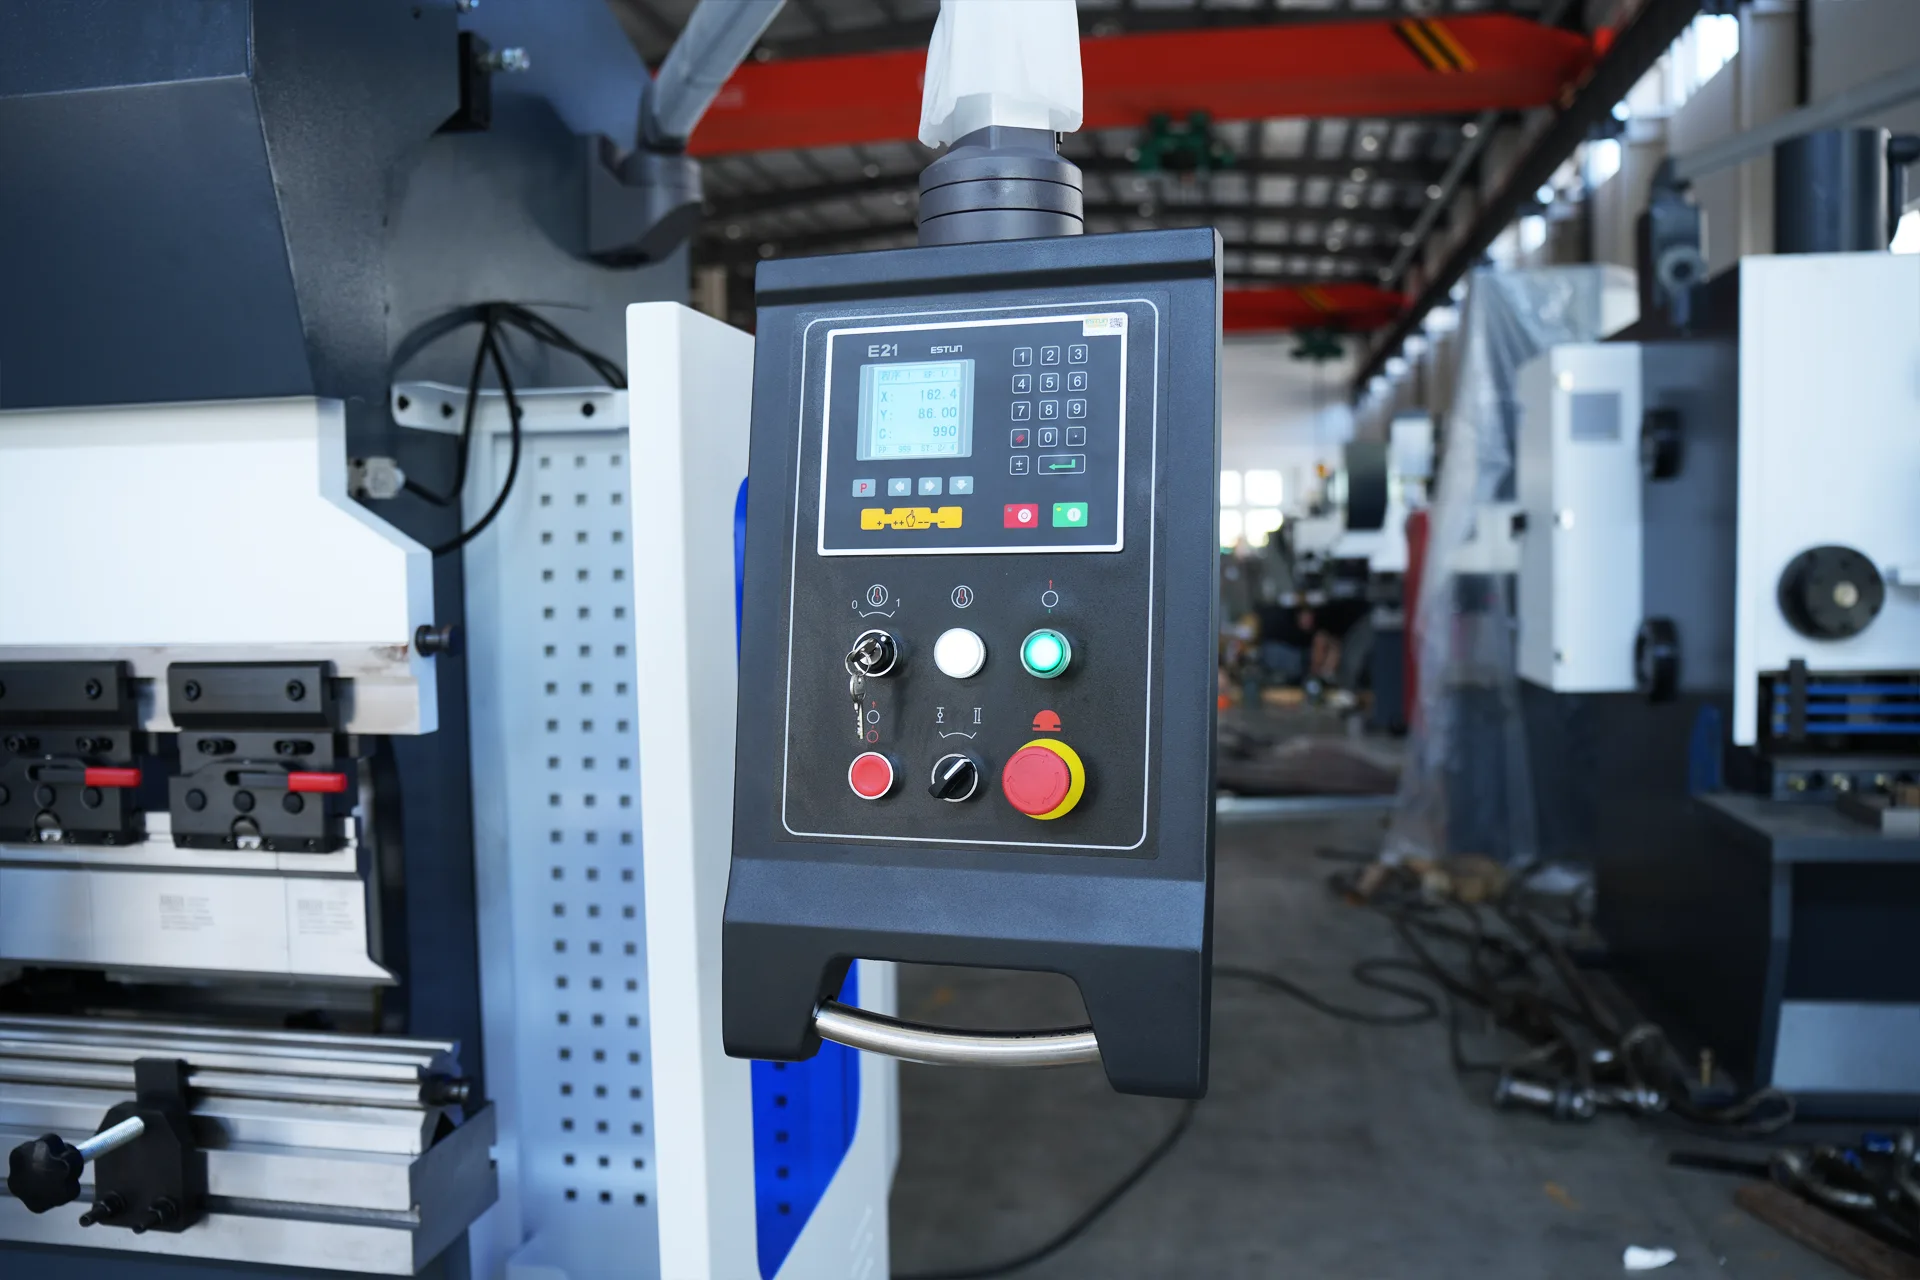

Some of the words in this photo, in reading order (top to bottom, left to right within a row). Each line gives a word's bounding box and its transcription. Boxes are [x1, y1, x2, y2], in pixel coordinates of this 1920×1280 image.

[868, 343, 898, 358] E21
[930, 344, 963, 354] ESTUN
[1019, 351, 1025, 363] 1
[1046, 350, 1054, 362] 2
[1074, 348, 1082, 360] 3
[1017, 378, 1026, 389] 4
[1045, 377, 1054, 388] 5
[1073, 375, 1082, 387] 6
[880, 391, 894, 403] X:
[920, 388, 957, 403] 162.4
[880, 409, 893, 422] Y:
[917, 406, 957, 419] 86.00
[1017, 405, 1026, 417] 7
[1045, 404, 1053, 416] 8
[1073, 403, 1081, 415] 9
[879, 428, 892, 440] C:
[932, 425, 956, 437] 990
[1044, 431, 1052, 443] 0
[860, 483, 867, 493] P
[851, 600, 858, 609] 0
[895, 598, 900, 607] 1
